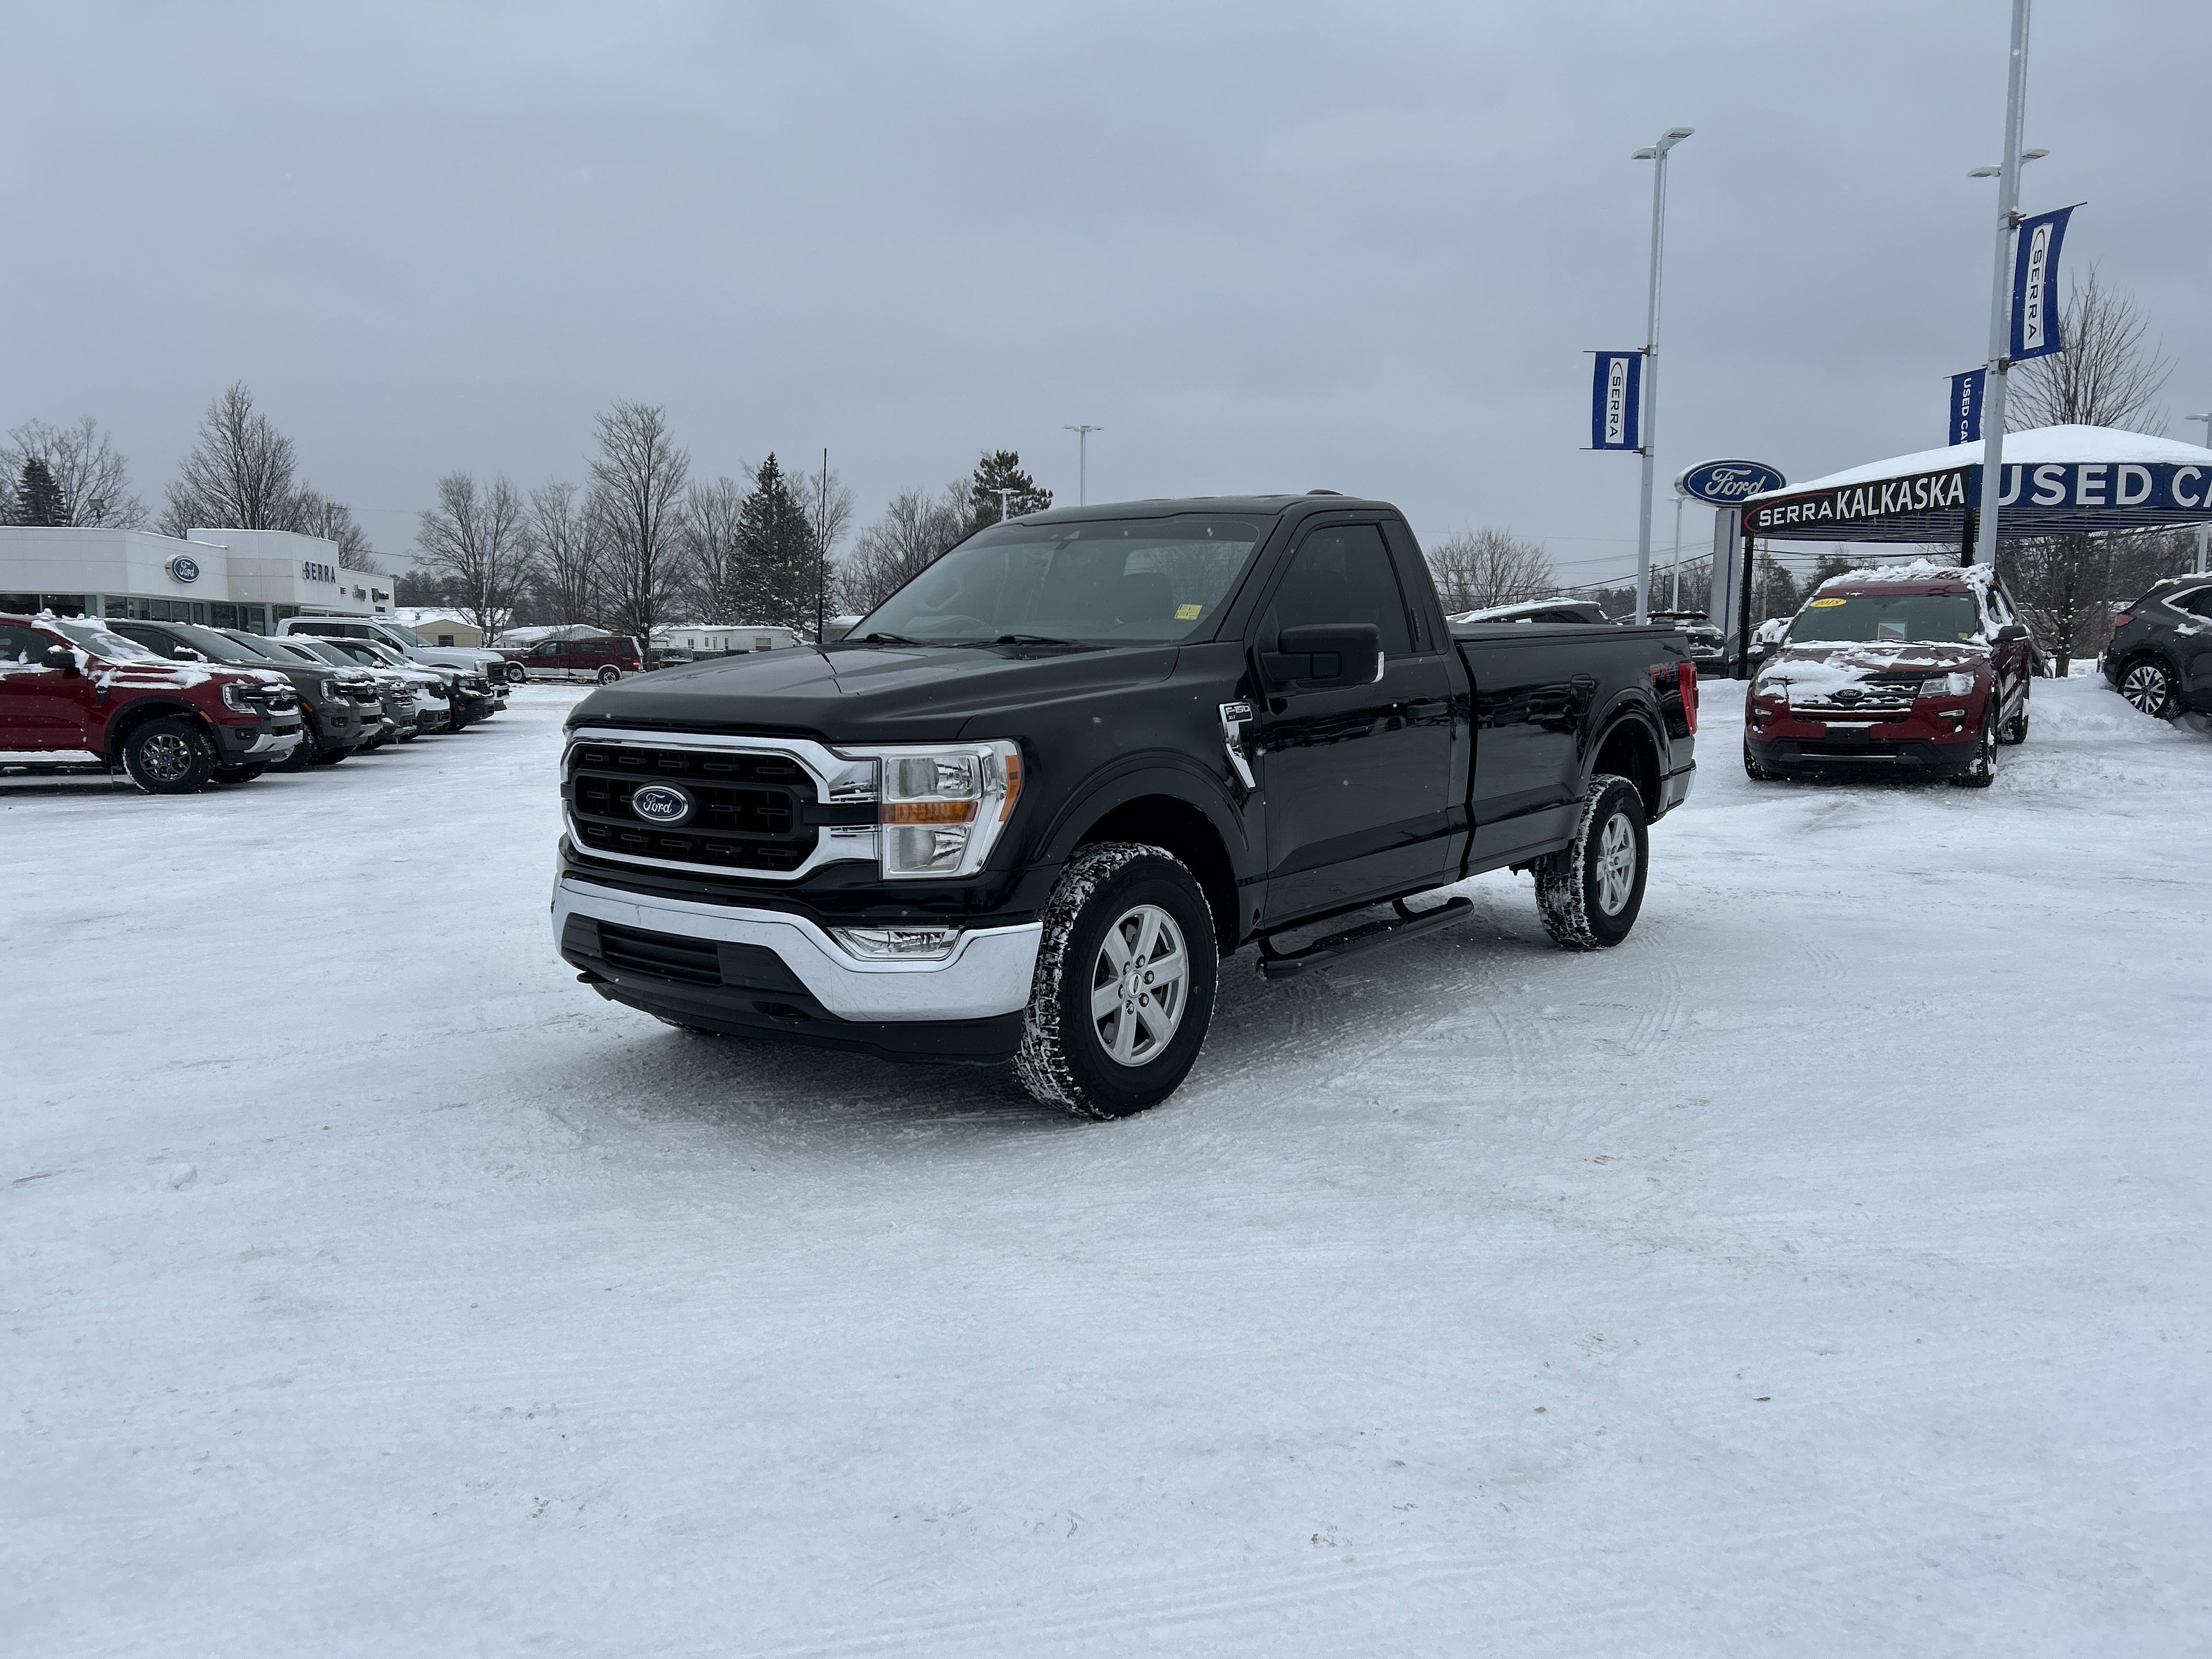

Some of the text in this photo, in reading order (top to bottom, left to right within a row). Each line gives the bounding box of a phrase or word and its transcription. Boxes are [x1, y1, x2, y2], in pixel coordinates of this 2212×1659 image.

[2028, 249, 2042, 340] SERRA
[1610, 376, 1621, 437] SERRA
[1961, 377, 1972, 416] USED
[1705, 468, 1767, 495] Ford
[1998, 465, 2212, 507] USED C
[1759, 473, 1965, 527] SERRA KALKASKA
[179, 560, 195, 577] Ford
[304, 561, 336, 583] SERRA
[1650, 662, 1679, 683] FX4
[1225, 705, 1250, 715] F-150
[643, 793, 673, 814] Ford
